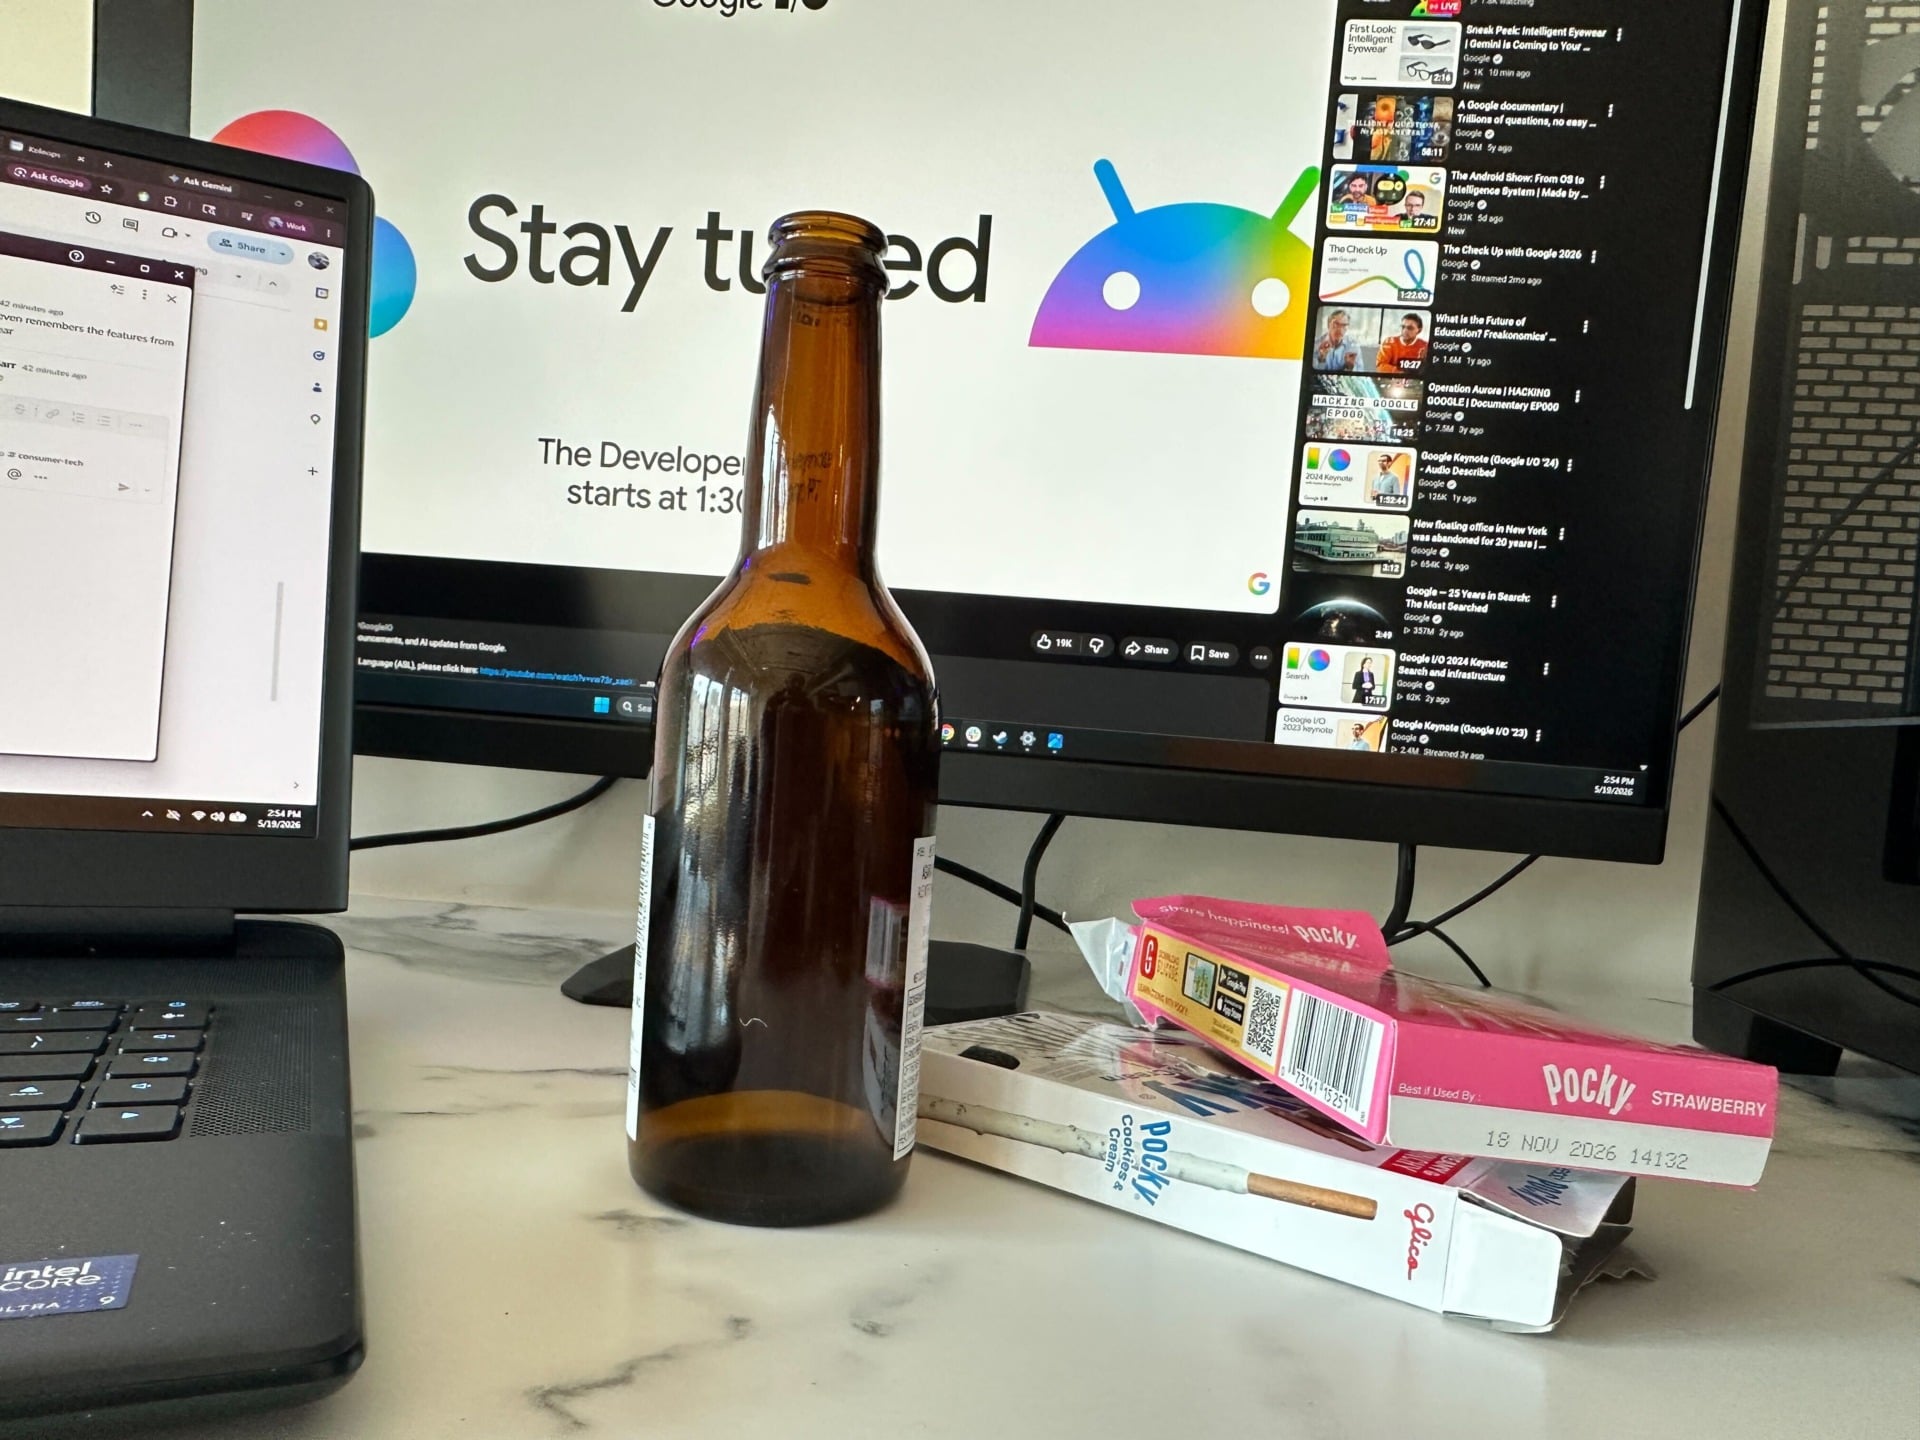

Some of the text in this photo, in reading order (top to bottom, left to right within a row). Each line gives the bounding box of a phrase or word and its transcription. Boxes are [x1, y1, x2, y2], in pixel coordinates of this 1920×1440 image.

[1350, 24, 1396, 33] First Look:
[1348, 34, 1393, 44] Intelligent
[1348, 44, 1387, 54] Eyewear
[1516, 70, 1531, 79] ago
[1463, 82, 1481, 90] New
[1458, 100, 1558, 113] A Google documentary
[1457, 114, 1588, 128] Trillions of questions, no easy
[31, 172, 84, 188] Ask Google
[184, 177, 232, 192] Ask Gemini
[1450, 185, 1580, 199] Intelligence System Made by
[286, 222, 306, 231] Work
[238, 242, 265, 254] Share
[463, 194, 992, 312] Stay tued
[1329, 244, 1387, 256] The Check Up
[1444, 245, 1582, 260] The Check Up with Google 2026
[13, 303, 46, 313] minutes
[1436, 314, 1526, 326] What is the Future of
[26, 318, 84, 333] remembers
[87, 326, 104, 335] the
[107, 329, 147, 343] features
[150, 336, 174, 347] from
[1400, 360, 1421, 369] 10:27
[36, 367, 69, 377] minutes
[1428, 382, 1550, 397] Operation Aurora HACKING
[18, 453, 83, 466] consumer-tech
[538, 438, 746, 481] The Develope
[1425, 465, 1496, 478] Audio Described
[1418, 479, 1445, 488] Google
[568, 481, 651, 509] starts
[659, 486, 687, 511] at
[1414, 519, 1547, 536] New floating office in New York
[1431, 533, 1479, 545] abandoned
[1481, 535, 1493, 545] for
[1495, 537, 1507, 546] 20
[1509, 539, 1532, 549] years
[1411, 547, 1437, 556] Google
[1248, 572, 1270, 595] G
[1407, 586, 1530, 602] Google 25 Years in Search:
[1405, 599, 1488, 613] The Most Searched
[1404, 613, 1430, 623] Google
[1449, 630, 1464, 638] ago
[429, 641, 458, 649] updates
[460, 641, 477, 650] from
[479, 643, 507, 653] Google.
[1056, 638, 1072, 648] 19K
[1145, 645, 1168, 655] Share
[1209, 650, 1229, 659] Save
[358, 658, 393, 668] Language
[417, 662, 441, 671] please
[443, 664, 459, 673] click
[1400, 653, 1508, 669] Google I/O 2024 Keynote:
[1397, 680, 1422, 689] Google
[1391, 733, 1417, 742] Google
[1604, 776, 1634, 785] 2:54 PM
[1594, 786, 1633, 796] 5/19/2026
[268, 809, 284, 817] 2:54
[257, 820, 301, 829] 5/19/2026
[1208, 910, 1288, 935] happiness!
[1293, 925, 1358, 949] Pocky
[1296, 1071, 1318, 1095] 73141
[1399, 1083, 1421, 1094] Best
[1424, 1086, 1430, 1094] if
[1433, 1087, 1459, 1099] Used
[1543, 1064, 1766, 1117] Pocky STRAWBERRY
[1105, 1127, 1120, 1172] Cream
[1113, 1114, 1134, 1191] Cookies &
[1487, 1130, 1689, 1170] 18 NOV 2026 14132
[1140, 1121, 1172, 1206] Pocky
[3, 1261, 91, 1281] intel
[100, 1295, 115, 1304] 9
